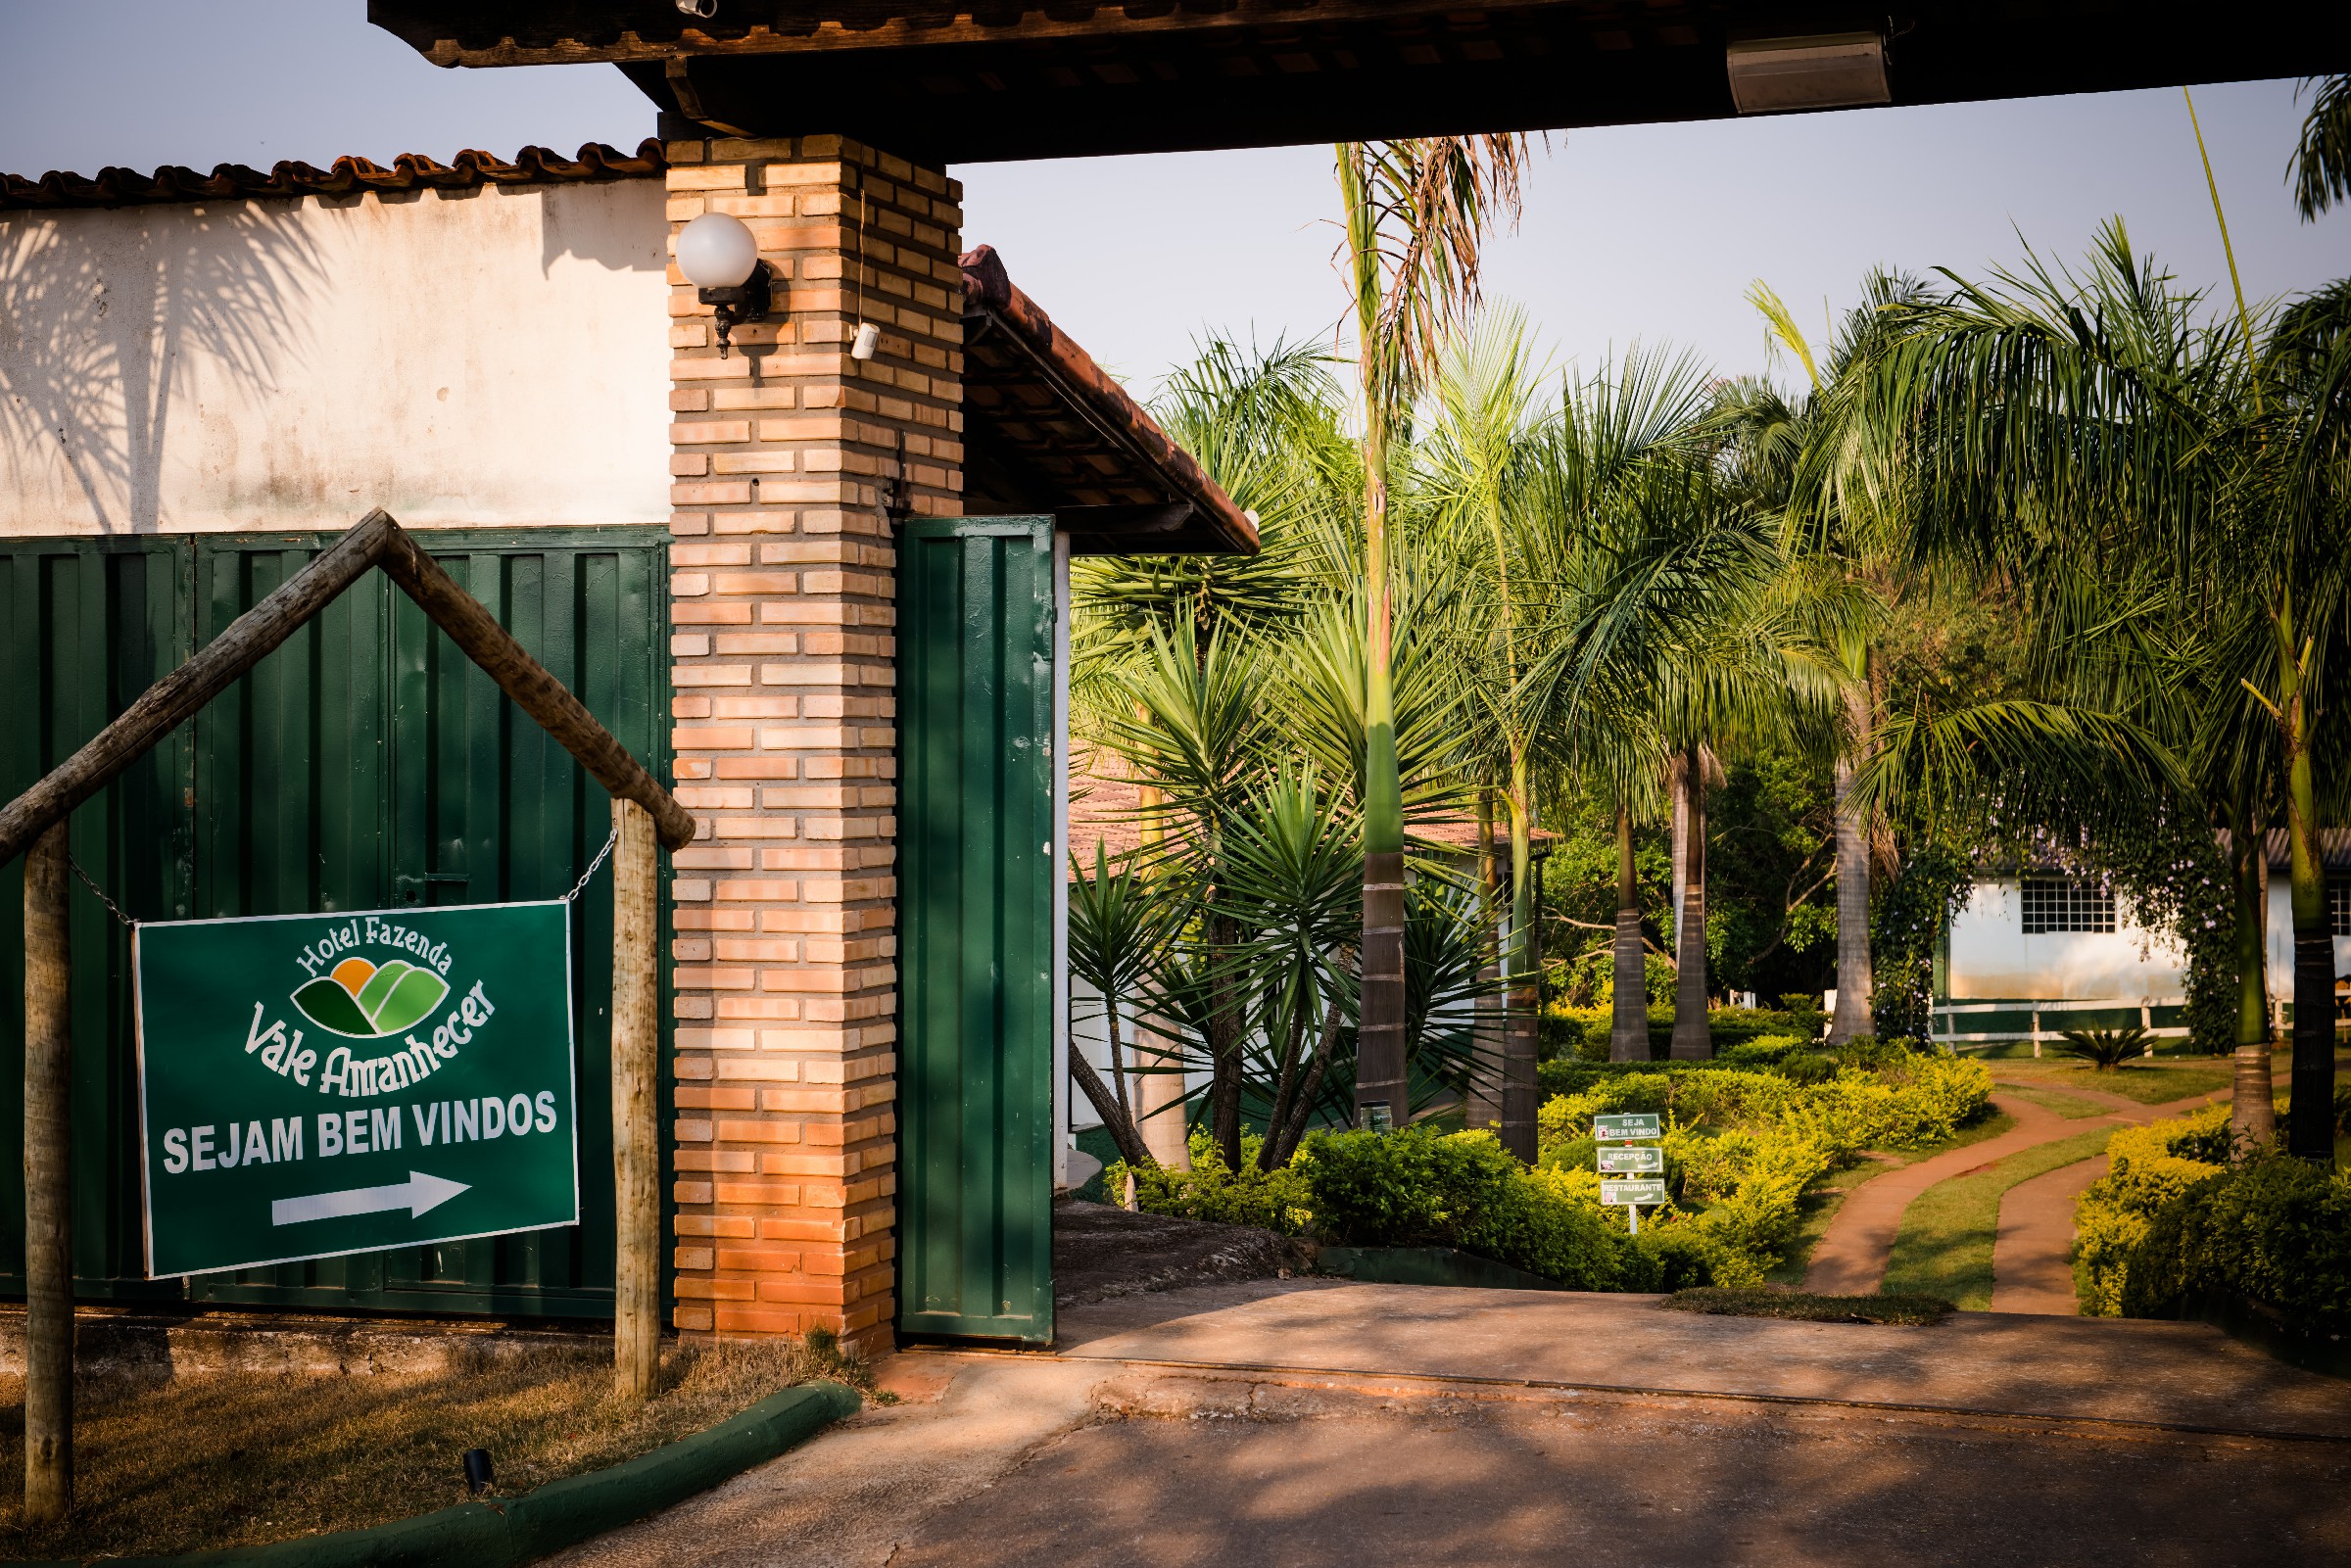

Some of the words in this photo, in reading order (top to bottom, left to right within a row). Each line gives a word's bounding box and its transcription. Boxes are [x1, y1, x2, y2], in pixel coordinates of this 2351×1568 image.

[296, 918, 360, 977] Hotel
[365, 917, 454, 975] Fazenda
[244, 1001, 316, 1087] Vale
[319, 979, 496, 1098] Amanhecer
[163, 1116, 304, 1174] SEJAM
[317, 1106, 402, 1158] BEM
[411, 1090, 557, 1146] VINDOS
[1629, 1127, 1657, 1136] VINDO
[1607, 1151, 1653, 1162] RECEPÇÃO
[1604, 1183, 1662, 1192] RESTAURANTE
